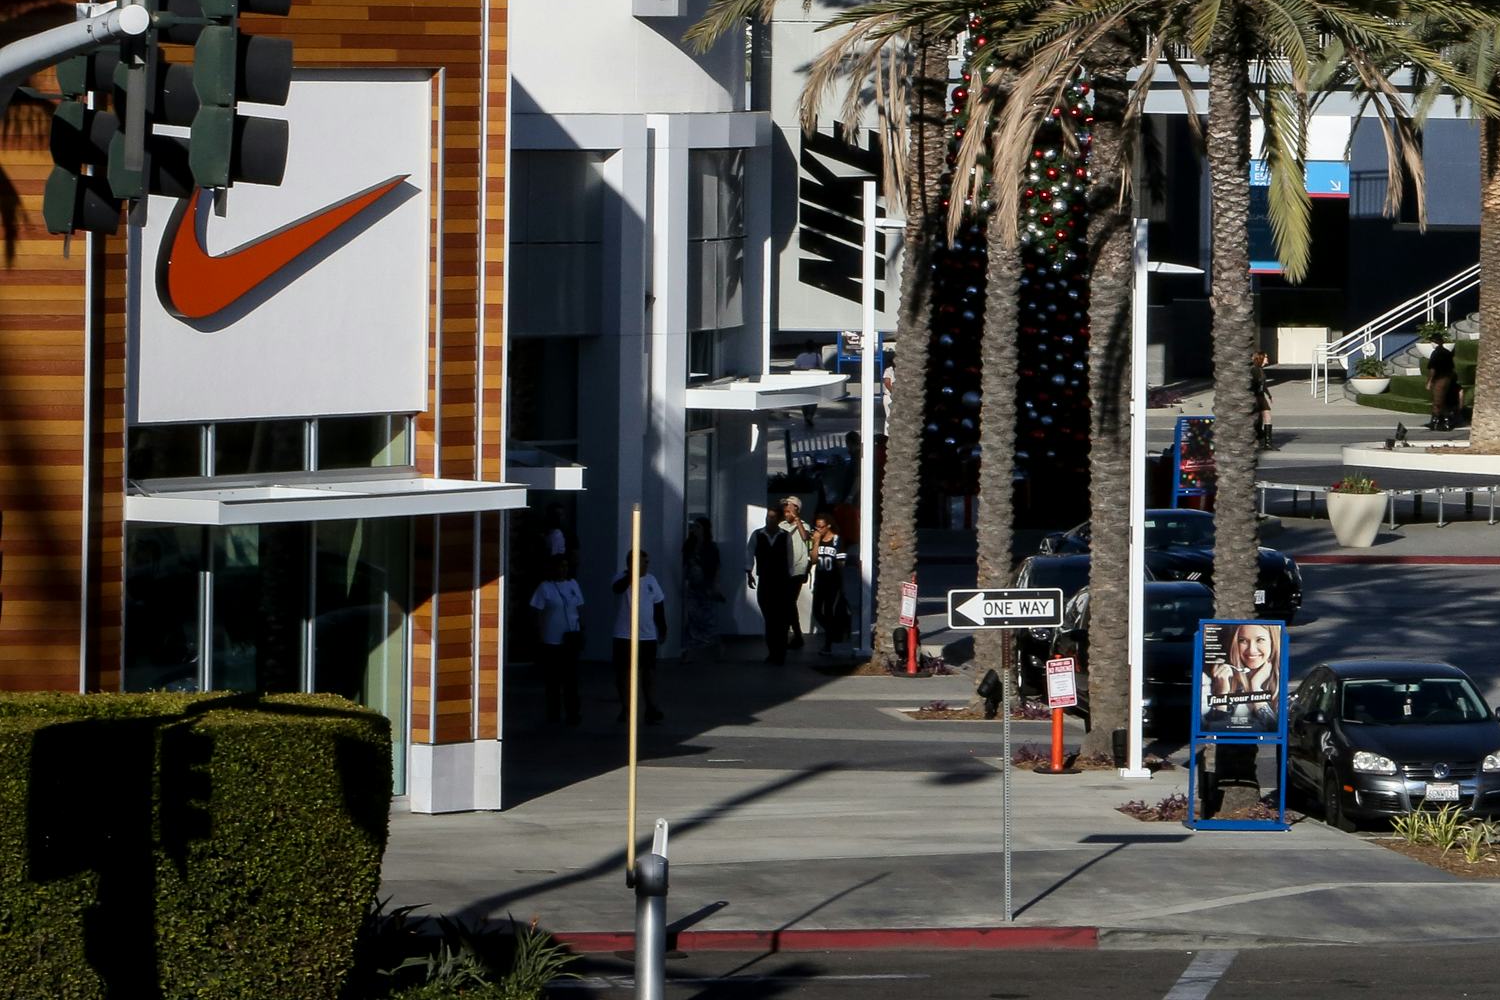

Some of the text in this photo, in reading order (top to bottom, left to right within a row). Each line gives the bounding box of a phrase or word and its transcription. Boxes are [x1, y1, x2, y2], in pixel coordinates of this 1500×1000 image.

[984, 601, 1049, 616] ONE WAY
[1209, 692, 1272, 706] find your taste
